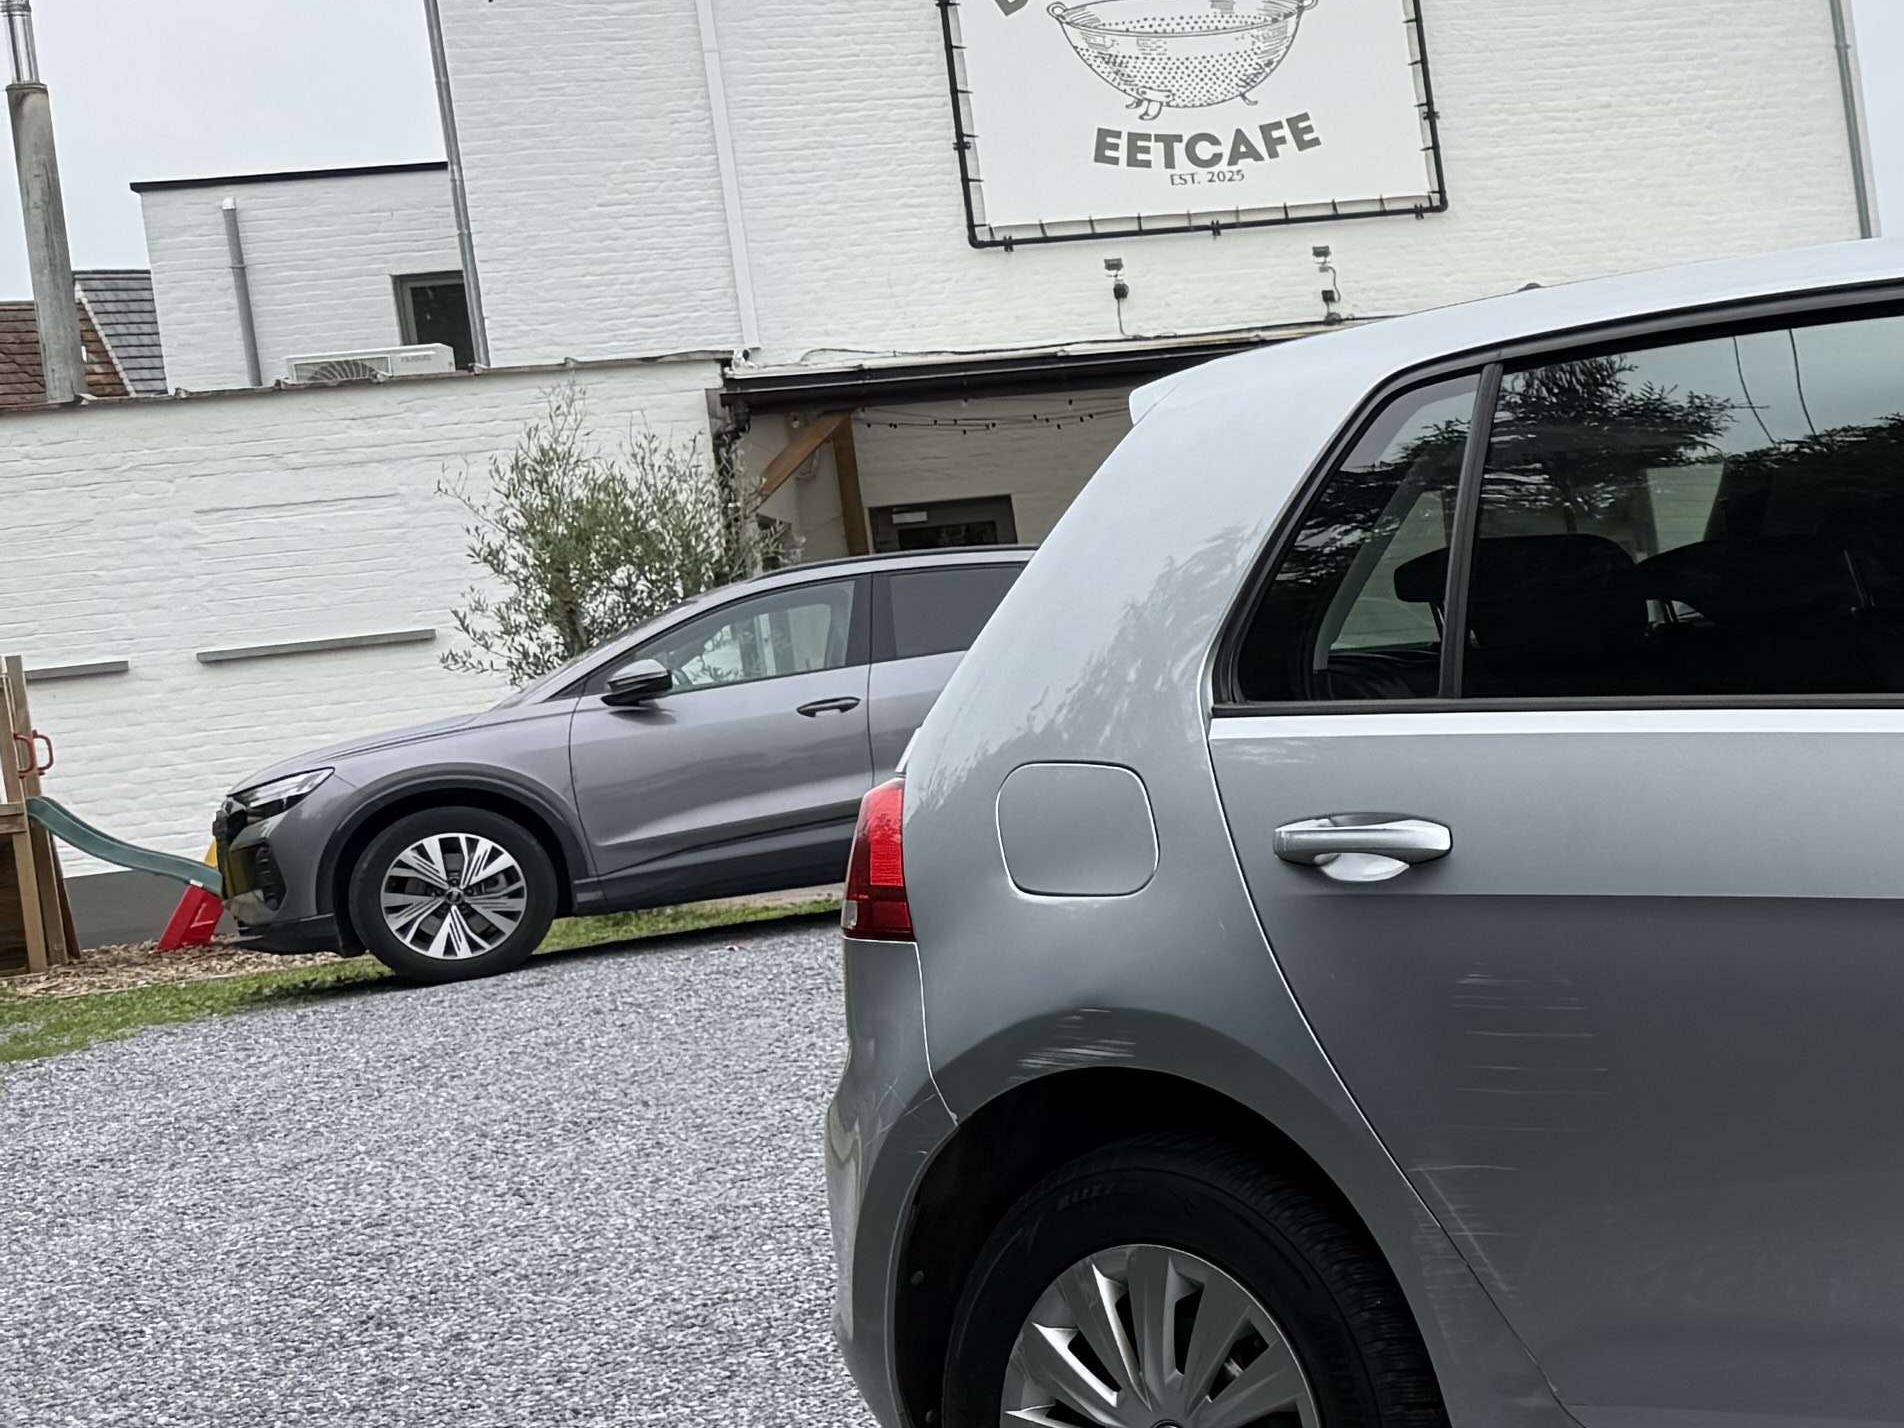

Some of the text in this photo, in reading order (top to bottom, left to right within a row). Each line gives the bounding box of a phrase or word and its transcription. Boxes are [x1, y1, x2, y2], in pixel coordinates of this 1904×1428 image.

[1093, 113, 1322, 169] EETCAFE
[1170, 169, 1245, 187] EST. 2025
